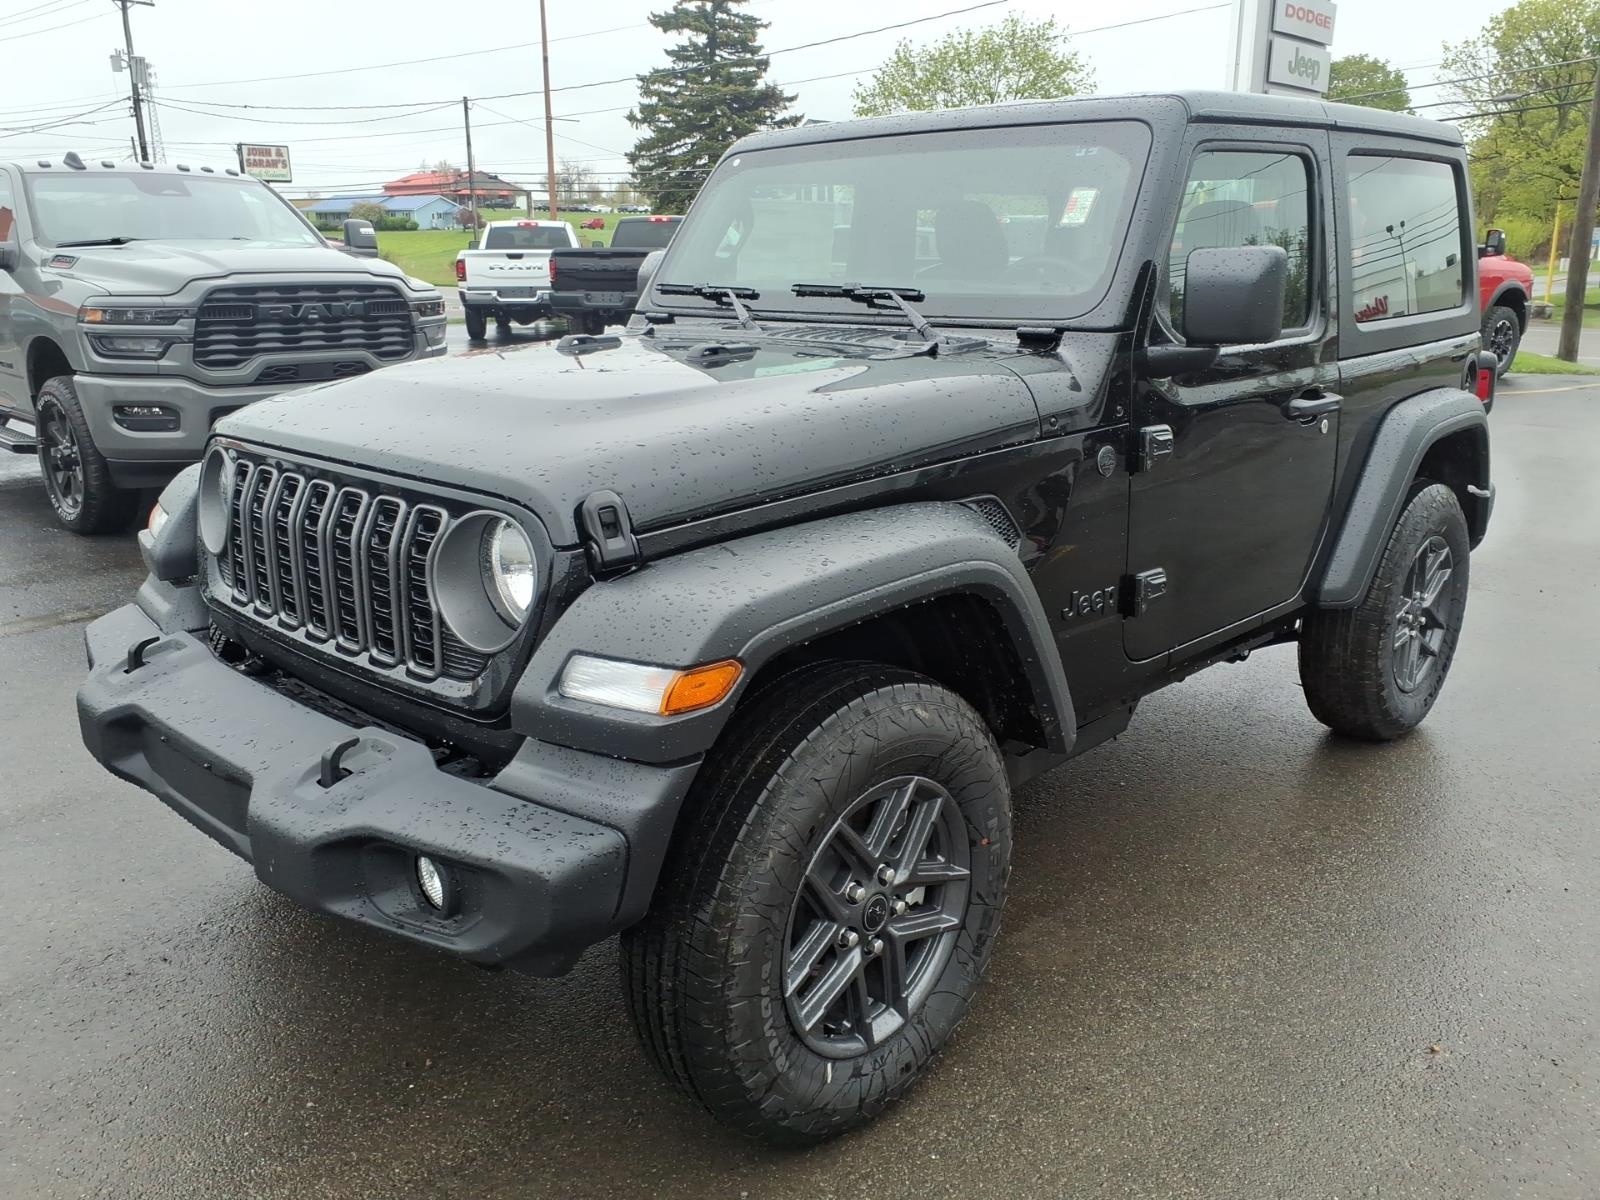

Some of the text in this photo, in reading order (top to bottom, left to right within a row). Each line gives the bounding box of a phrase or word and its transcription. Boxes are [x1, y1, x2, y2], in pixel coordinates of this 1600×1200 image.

[1285, 3, 1332, 30] DODGE
[1288, 46, 1320, 85] Jeep
[247, 147, 284, 158] JOHN &
[245, 158, 288, 169] SARAH'S
[489, 263, 544, 271] RAM
[258, 302, 364, 322] RAM
[1061, 586, 1118, 620] Jeep
